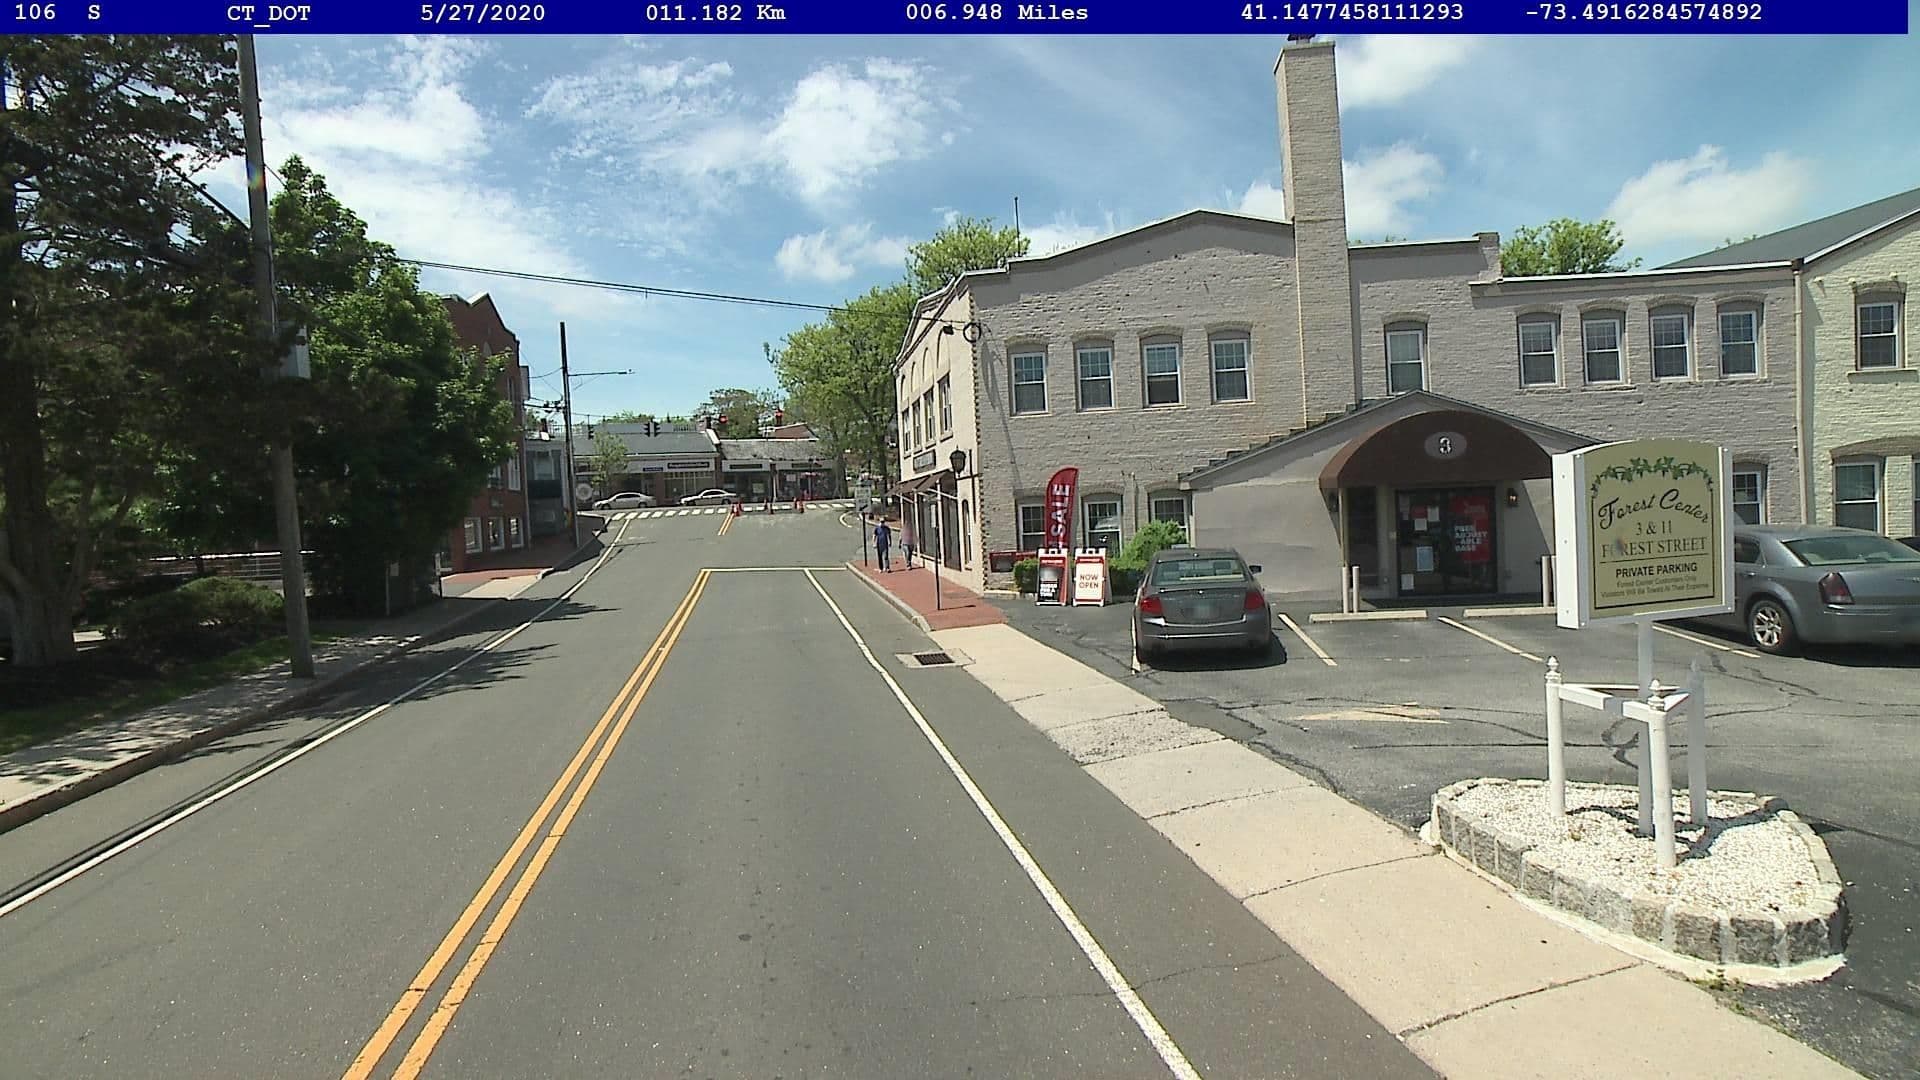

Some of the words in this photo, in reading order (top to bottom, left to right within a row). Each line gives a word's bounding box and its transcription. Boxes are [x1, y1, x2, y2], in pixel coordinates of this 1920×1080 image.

[1440, 437, 1451, 453] 3
[1051, 484, 1070, 537] SALE
[1598, 494, 1655, 530] Forest
[1660, 489, 1708, 523] Center
[1635, 521, 1642, 536] 3
[1646, 520, 1657, 535] &
[1601, 540, 1655, 558] FREST
[1657, 537, 1707, 554] STREET
[1615, 565, 1655, 579] PRIVATE
[1657, 562, 1697, 575] PARKING
